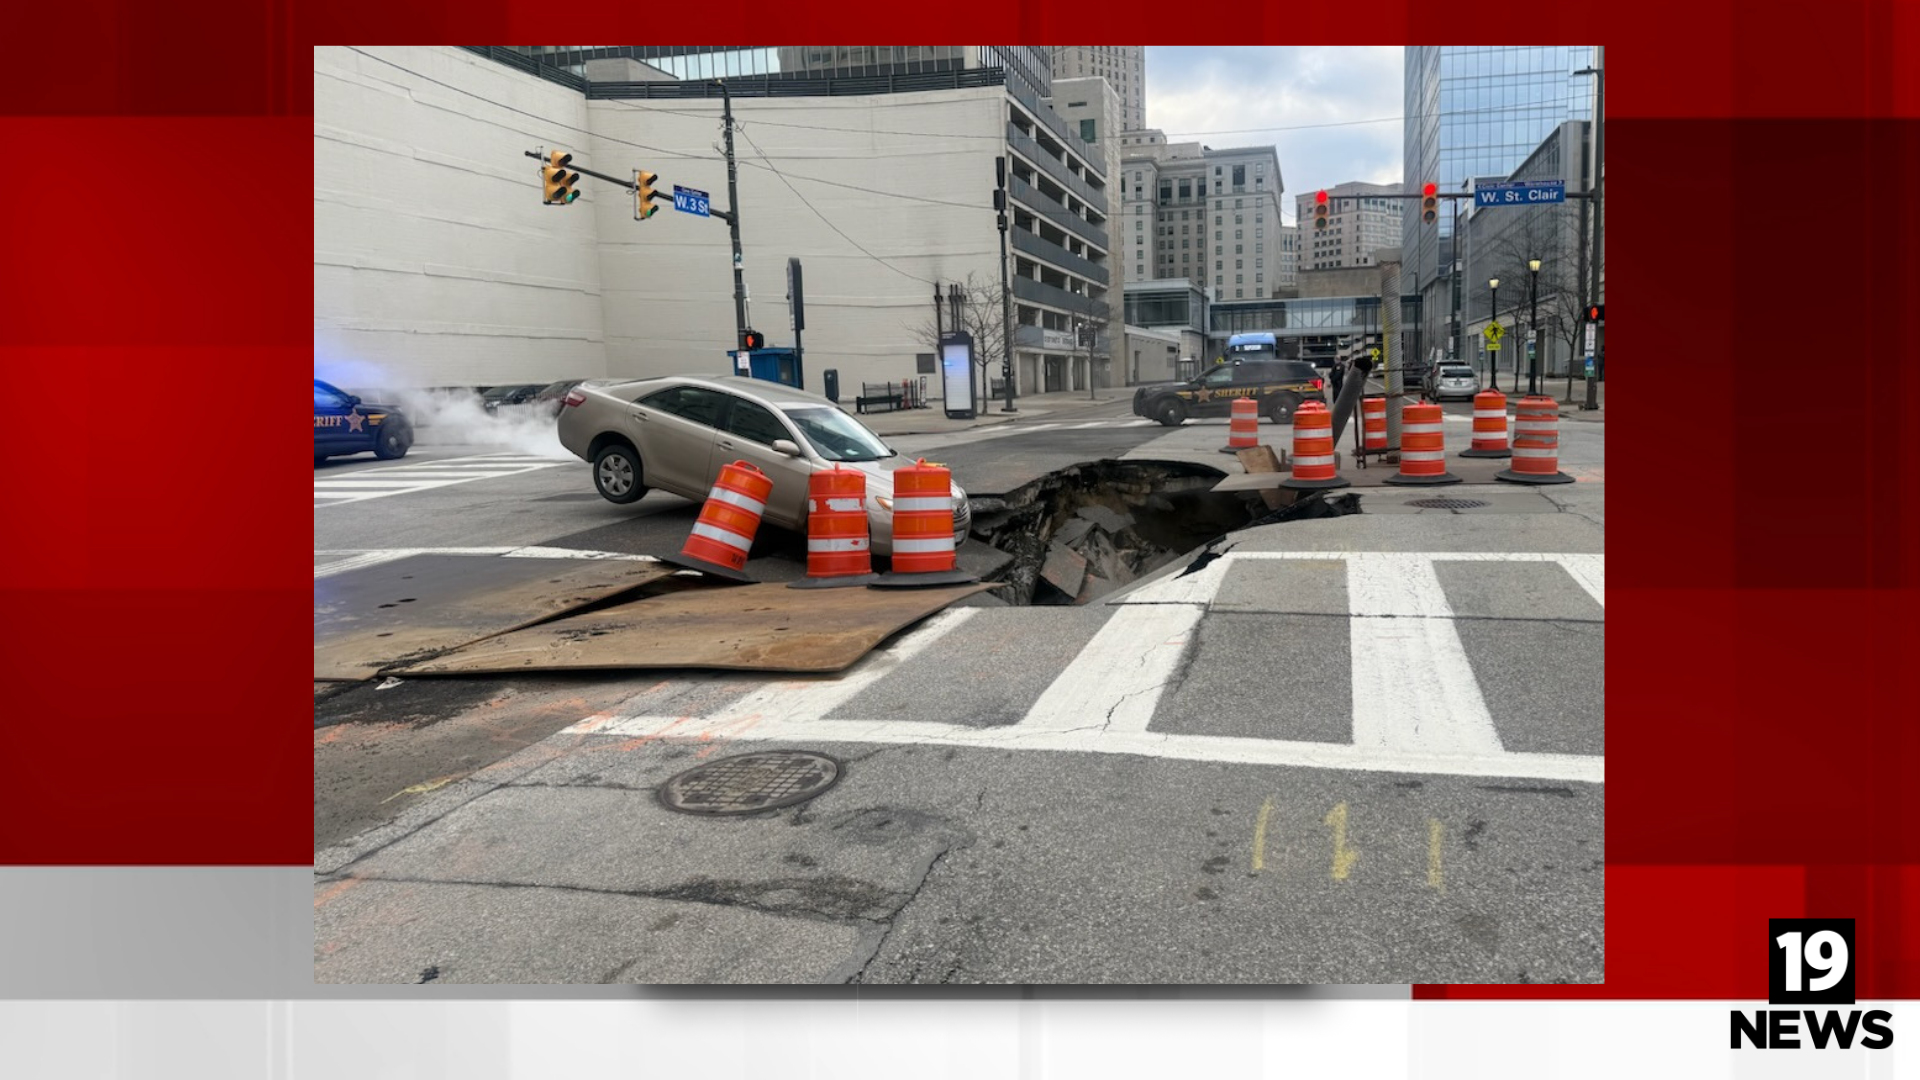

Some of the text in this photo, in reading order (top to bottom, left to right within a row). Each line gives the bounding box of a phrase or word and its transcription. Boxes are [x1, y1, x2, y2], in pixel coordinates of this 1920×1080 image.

[1481, 188, 1559, 203] W. St. Clair
[1214, 387, 1259, 398] SHERIFF
[314, 415, 343, 427] RIFF
